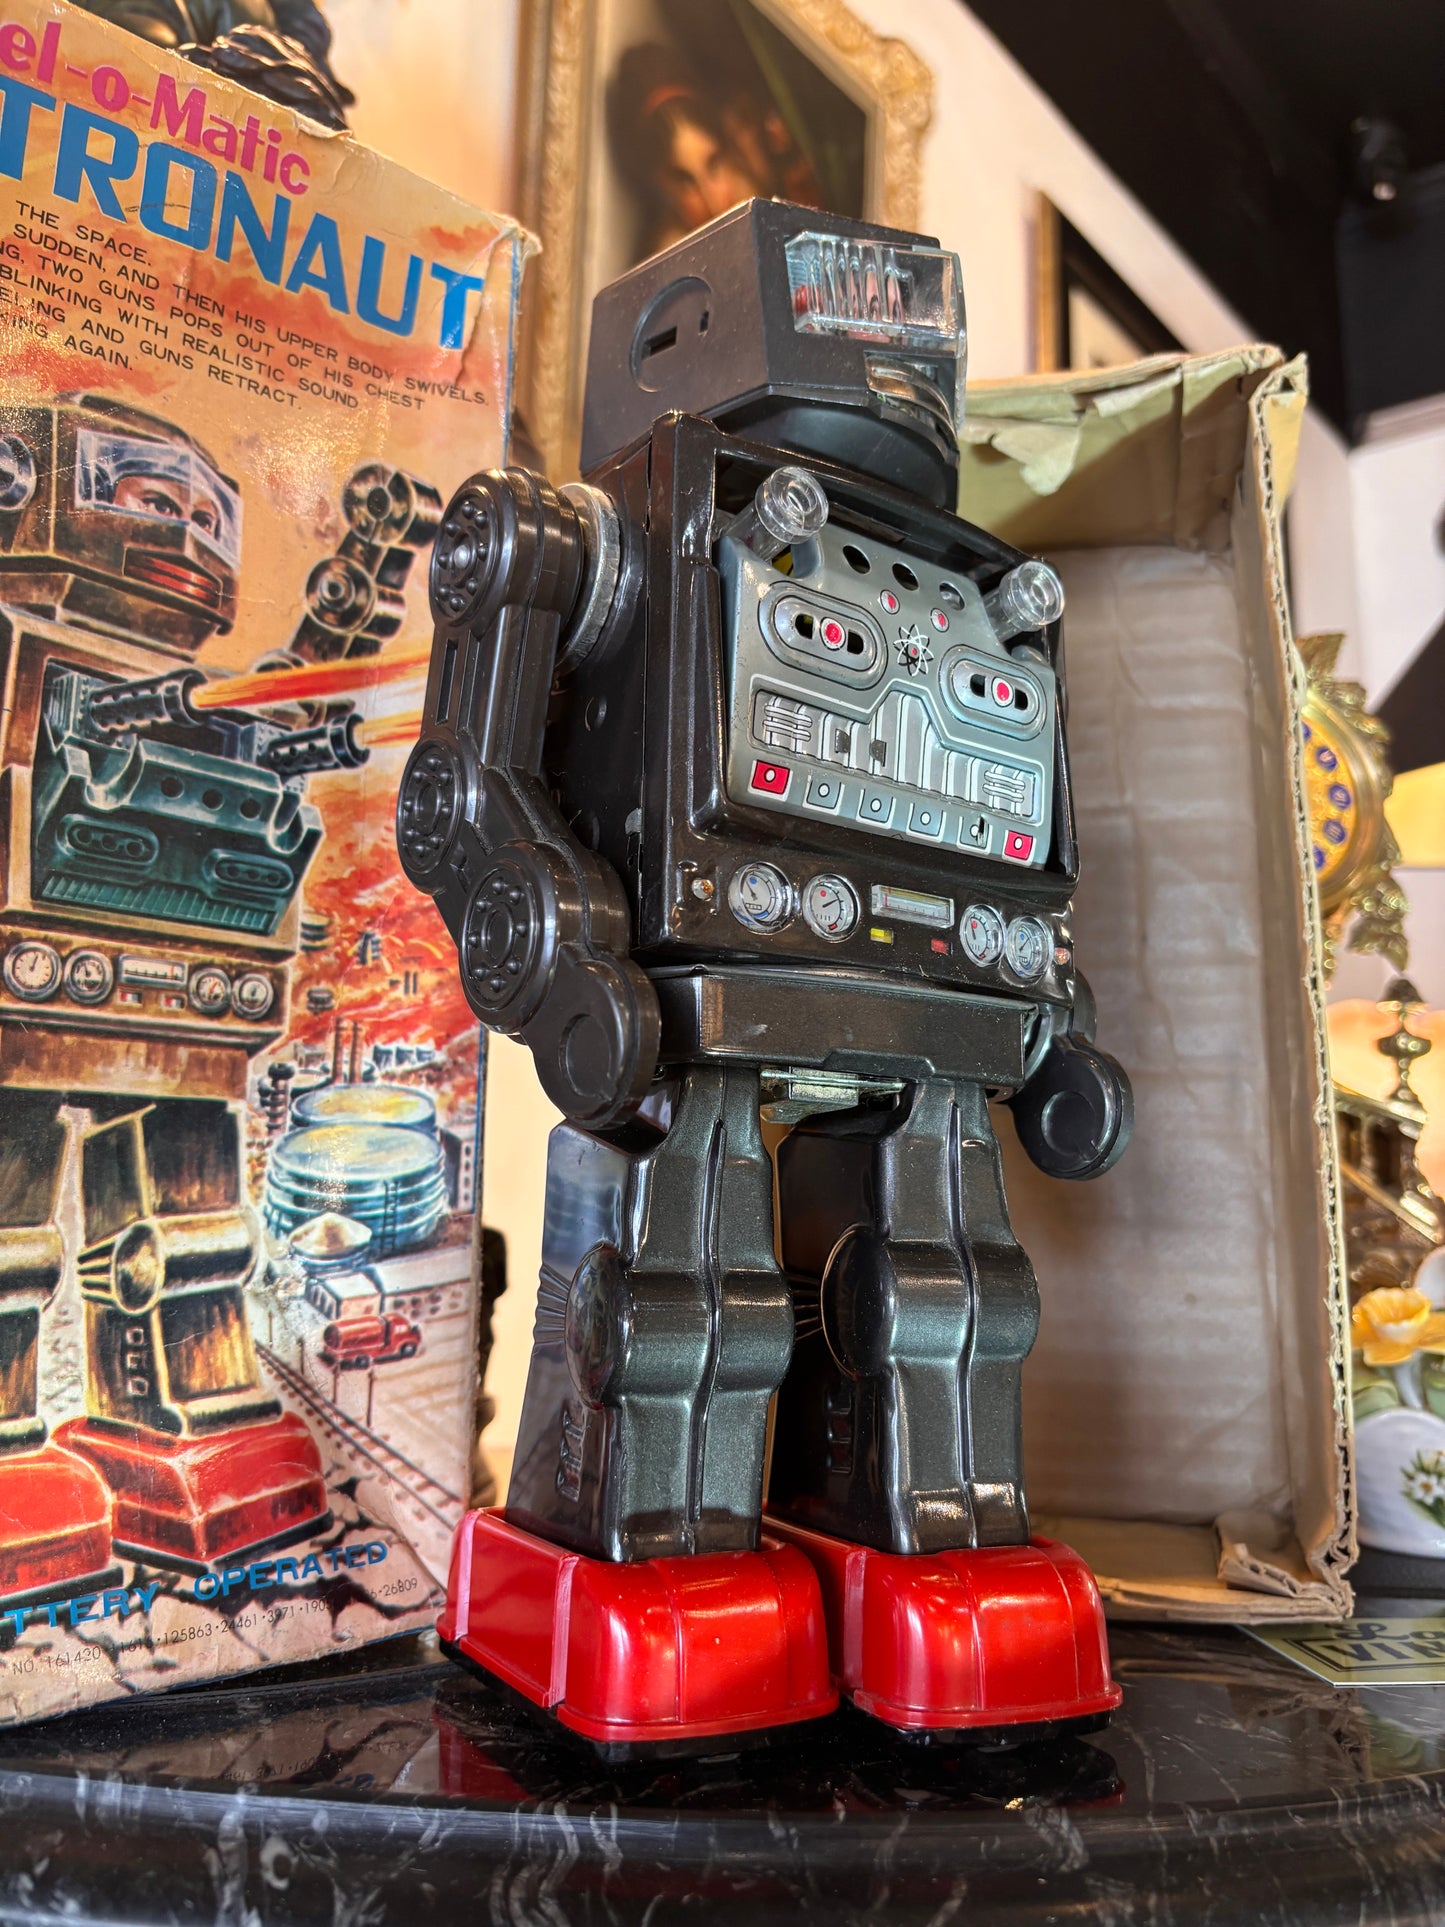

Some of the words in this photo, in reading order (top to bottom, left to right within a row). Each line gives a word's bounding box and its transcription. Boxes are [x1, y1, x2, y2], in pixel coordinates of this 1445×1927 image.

[0, 21, 311, 195] el-o-Matic
[0, 74, 485, 350] TRONAUT
[15, 200, 60, 230] THE
[75, 225, 152, 266] SPACE.
[0, 264, 102, 313] BLINKING
[118, 308, 168, 339] WITH
[182, 333, 285, 383] REALISTIC
[298, 377, 359, 408] SOUND
[13, 224, 106, 273] SUDDEN,
[116, 265, 160, 290] AND
[172, 283, 225, 317] THEN
[235, 310, 266, 334] HIS
[277, 327, 338, 362] UPPER
[348, 356, 394, 380] BODY
[404, 377, 489, 405] SWIVELS.
[37, 254, 84, 283] TWO
[98, 279, 156, 311] GUNS
[170, 306, 223, 337] POPS
[236, 334, 275, 357] OUT
[287, 354, 312, 370] OF
[324, 366, 354, 387] HIS
[365, 383, 425, 410] CHEST
[64, 335, 133, 371] AGAIN.
[81, 319, 124, 344] AND
[139, 340, 194, 370] GUNS
[208, 365, 302, 410] RETRACT.
[4, 1582, 159, 1636] TTERY
[194, 1540, 388, 1601] OPERATED
